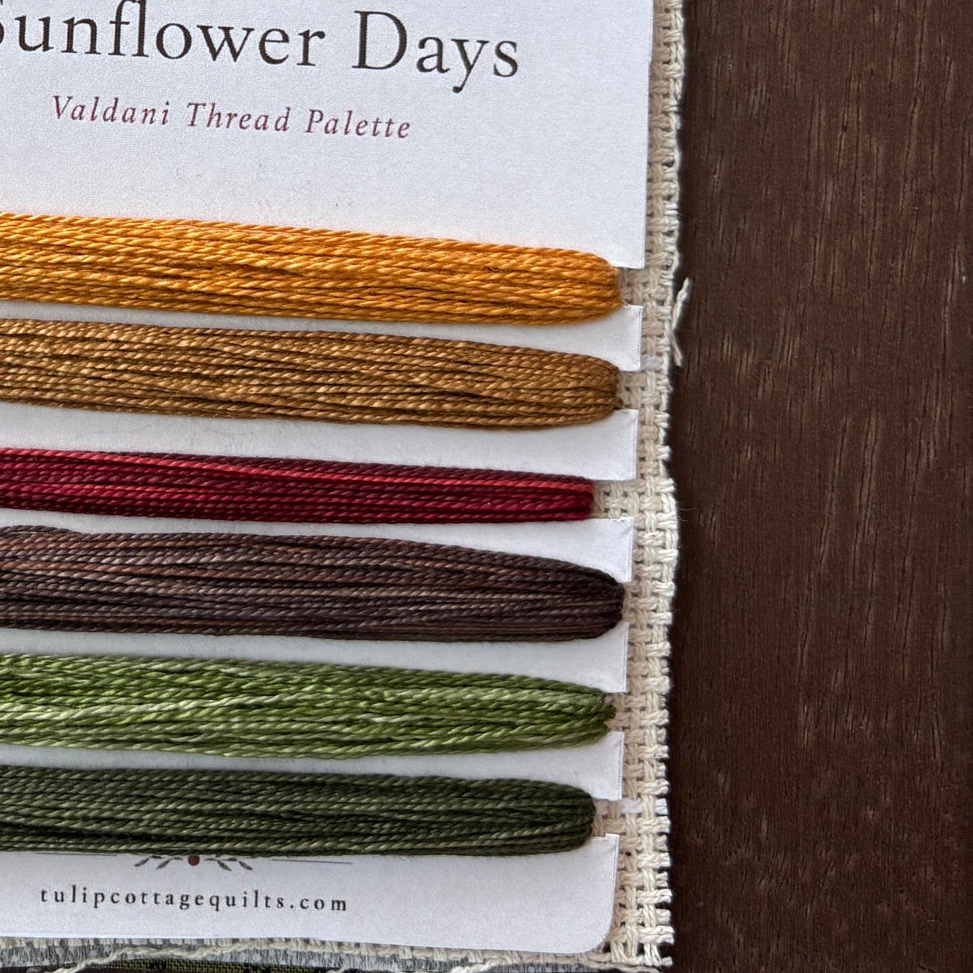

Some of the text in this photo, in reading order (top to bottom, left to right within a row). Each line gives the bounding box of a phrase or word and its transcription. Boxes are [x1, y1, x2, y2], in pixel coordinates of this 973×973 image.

[352, 9, 520, 94] Days
[52, 94, 412, 139] Valdani Thread Palette
[40, 885, 348, 912] tulipcottagequilts.com
